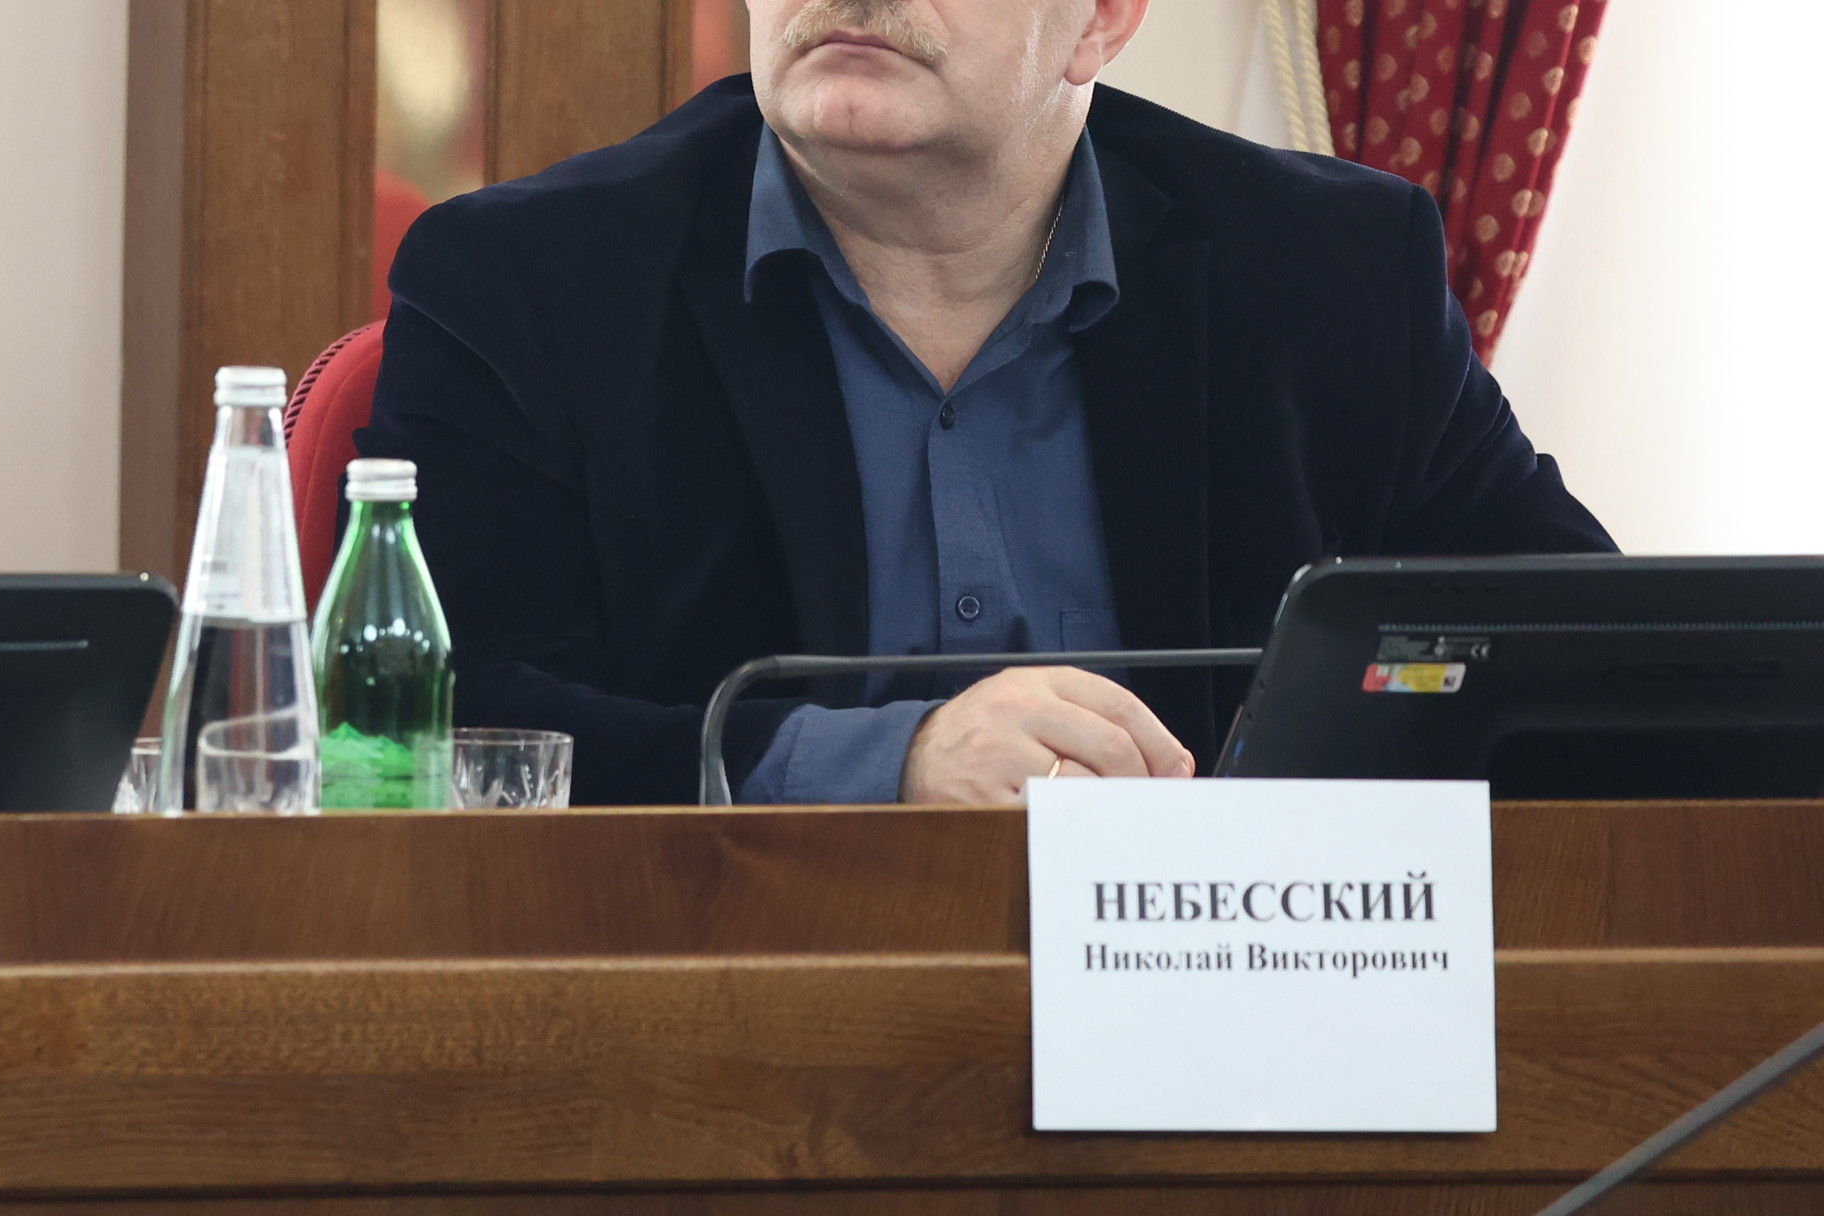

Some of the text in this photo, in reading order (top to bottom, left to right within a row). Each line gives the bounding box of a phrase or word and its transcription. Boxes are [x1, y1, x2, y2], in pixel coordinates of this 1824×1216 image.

[1093, 869, 1437, 923] НЕБЕССКИЙ
[1083, 942, 1450, 980] Николай Викторович
